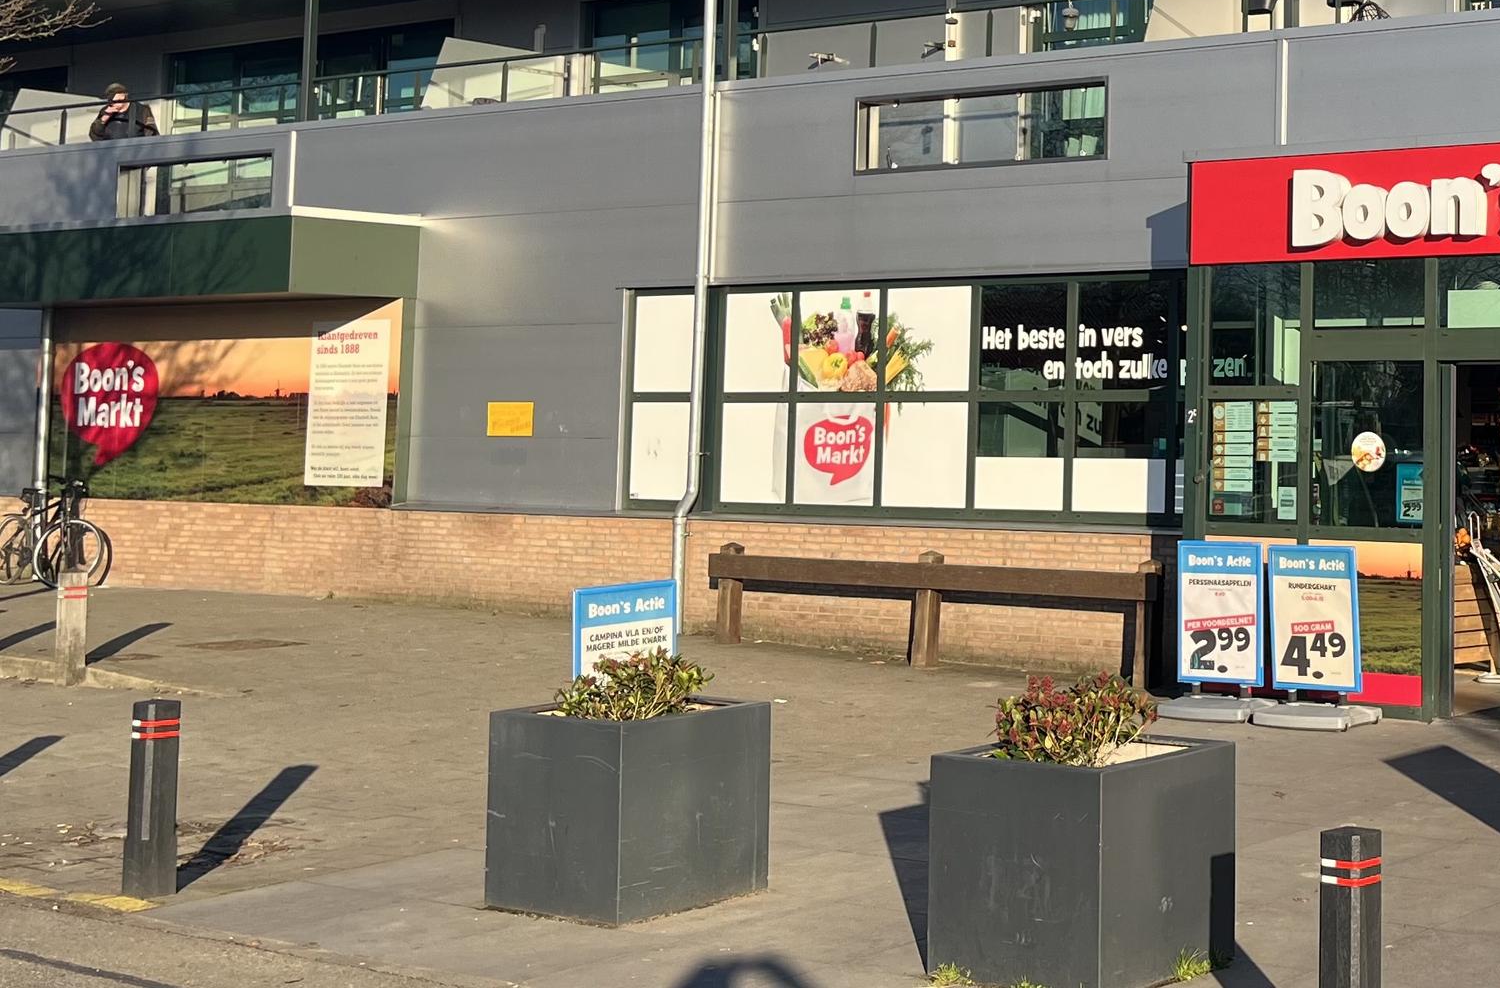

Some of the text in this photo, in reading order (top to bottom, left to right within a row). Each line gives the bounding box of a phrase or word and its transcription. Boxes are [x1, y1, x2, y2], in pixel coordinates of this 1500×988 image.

[981, 323, 1144, 350] Het beste in vers
[316, 343, 360, 355] sinds 1888
[1043, 359, 1065, 380] en
[1075, 351, 1114, 380] toch
[1118, 352, 1168, 380] zulke
[74, 359, 145, 394] Boon's
[77, 393, 143, 428] Markt
[814, 424, 866, 446] Boon's
[816, 445, 865, 465] Markt
[1188, 554, 1252, 568] Boon's Actie
[1279, 556, 1345, 572] Boon's Actie
[1287, 582, 1337, 591] RUNDERGEHAKT
[588, 596, 665, 619] Boon's Actie
[589, 625, 664, 643] CAMPINA VLA EN/OF
[1310, 623, 1332, 631] GRAM
[586, 634, 668, 652] MAGERE MILDE KWARK
